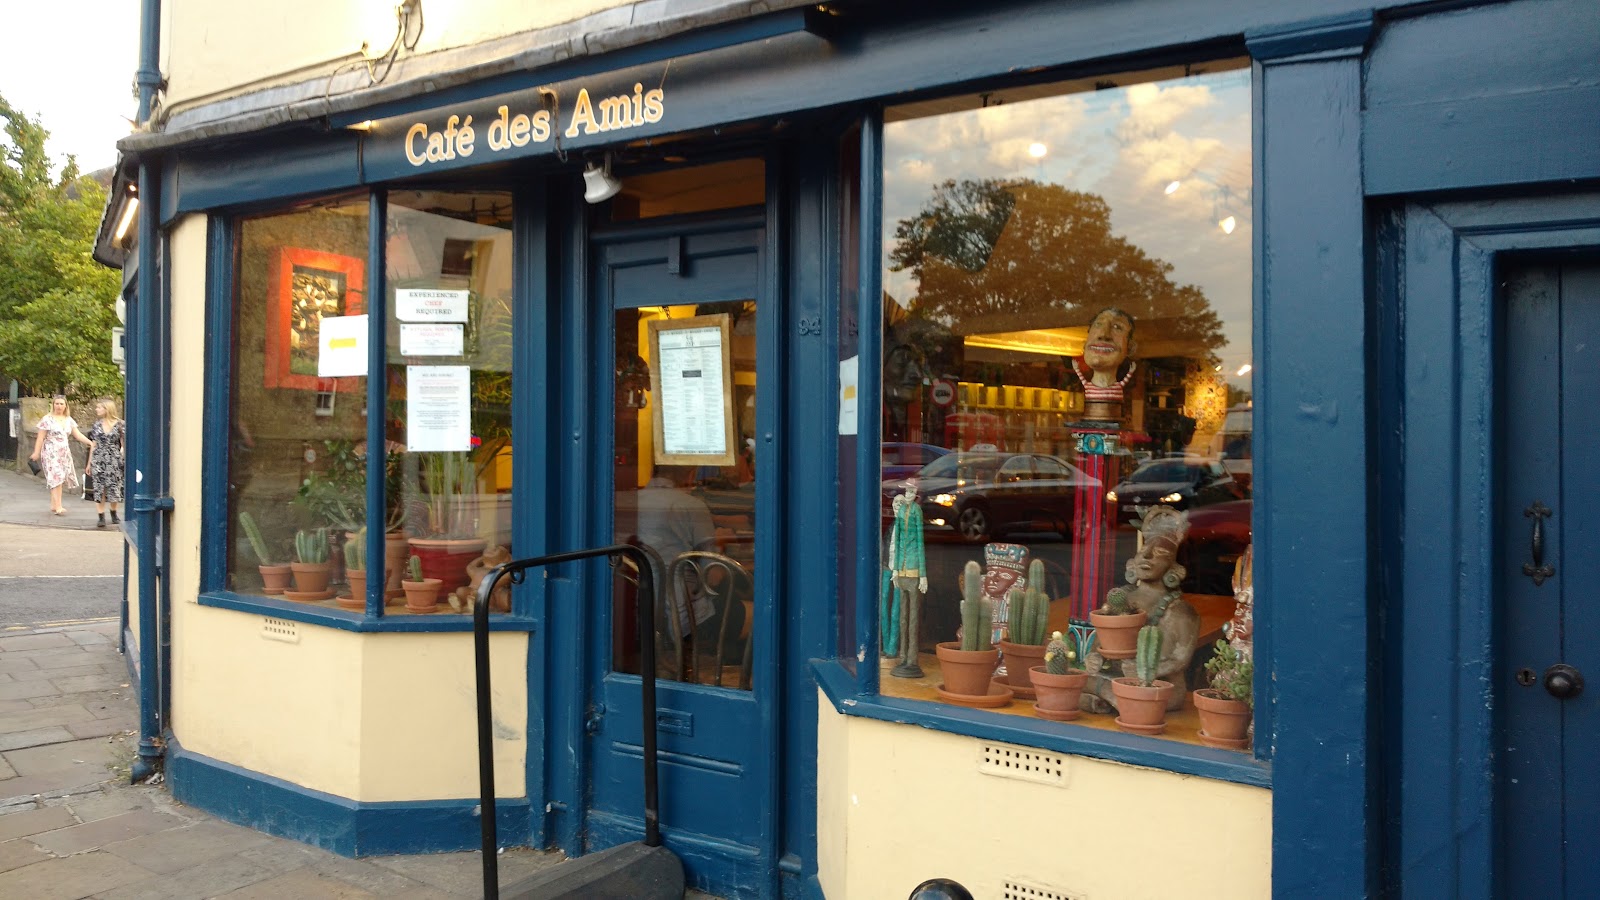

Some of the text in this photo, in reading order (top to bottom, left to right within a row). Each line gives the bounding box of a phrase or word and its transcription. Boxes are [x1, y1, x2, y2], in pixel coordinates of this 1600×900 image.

[405, 82, 664, 166] Café des Amis
